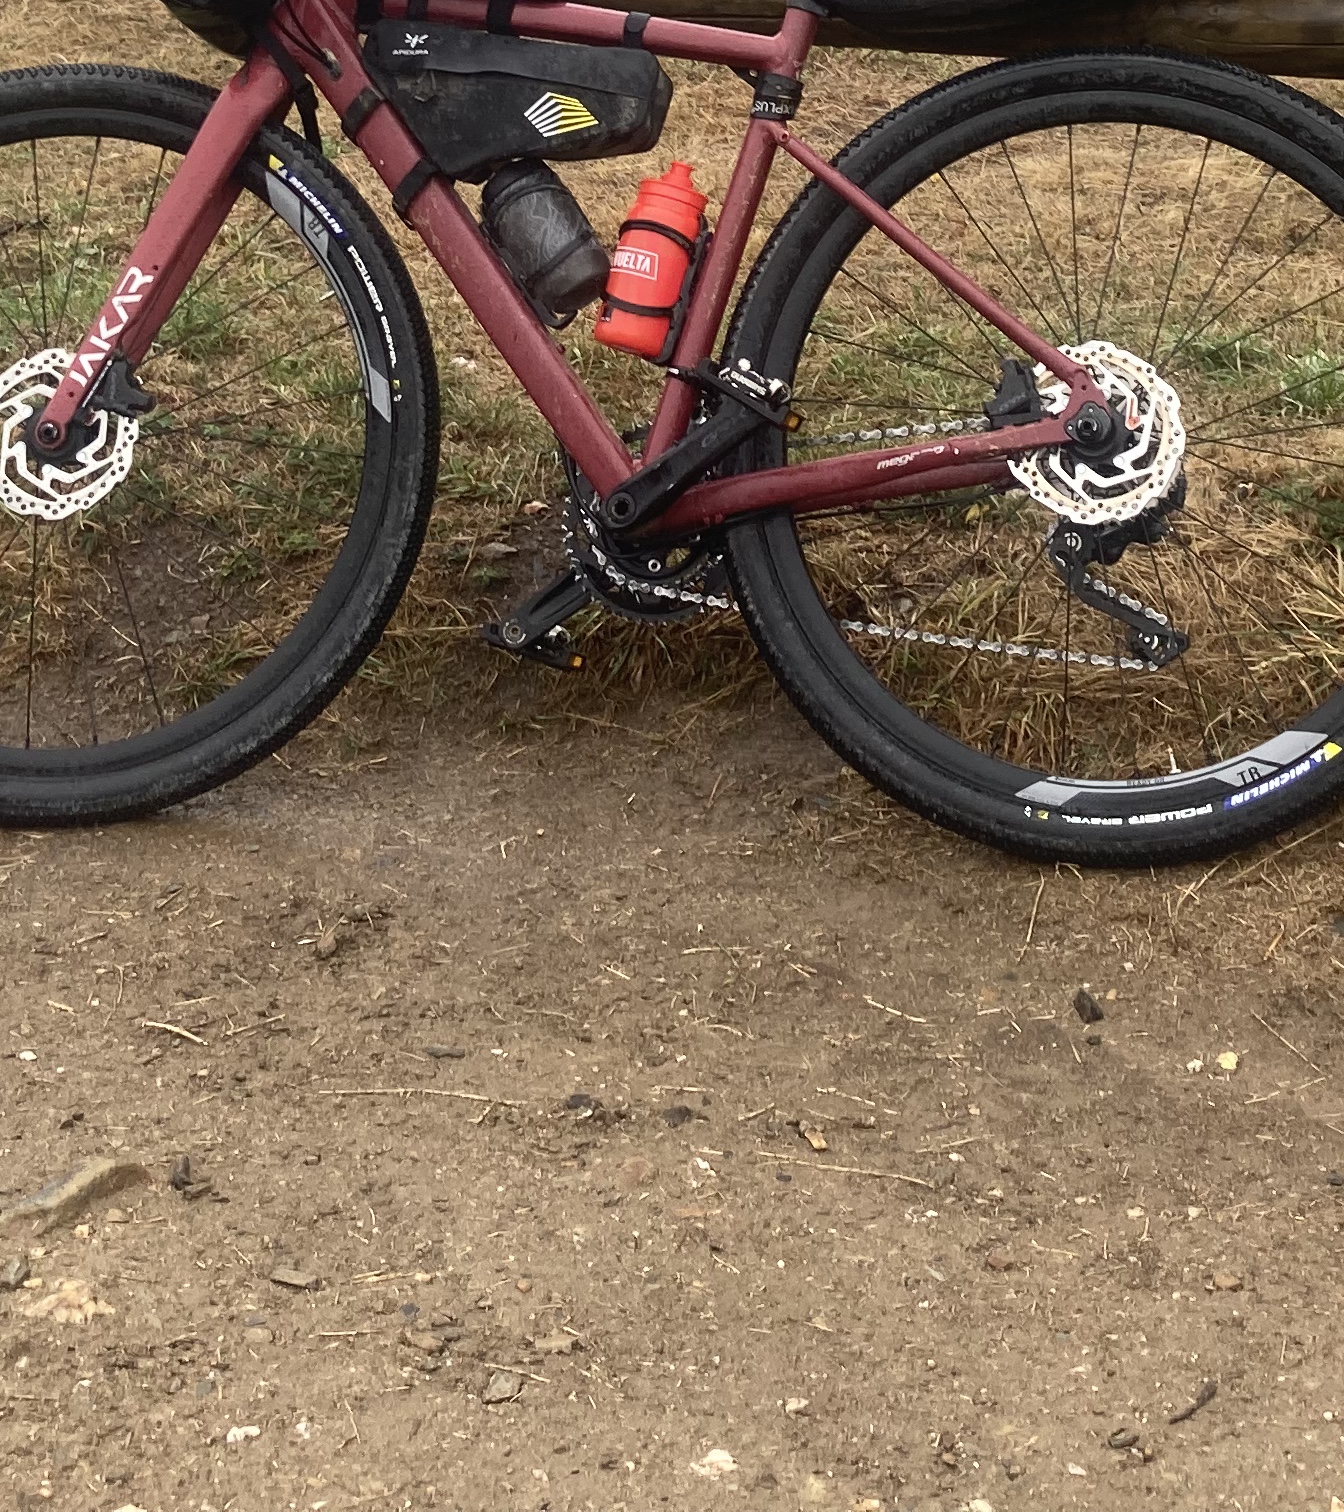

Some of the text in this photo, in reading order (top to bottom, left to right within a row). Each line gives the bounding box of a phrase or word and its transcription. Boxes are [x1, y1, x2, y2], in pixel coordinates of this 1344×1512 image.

[288, 176, 344, 234] MICHELIN
[347, 244, 384, 313] POWER
[1230, 759, 1312, 807] MICHELIN
[1236, 766, 1262, 786] TR
[1061, 814, 1123, 826] GRAVEL
[1128, 803, 1213, 825] POWER
